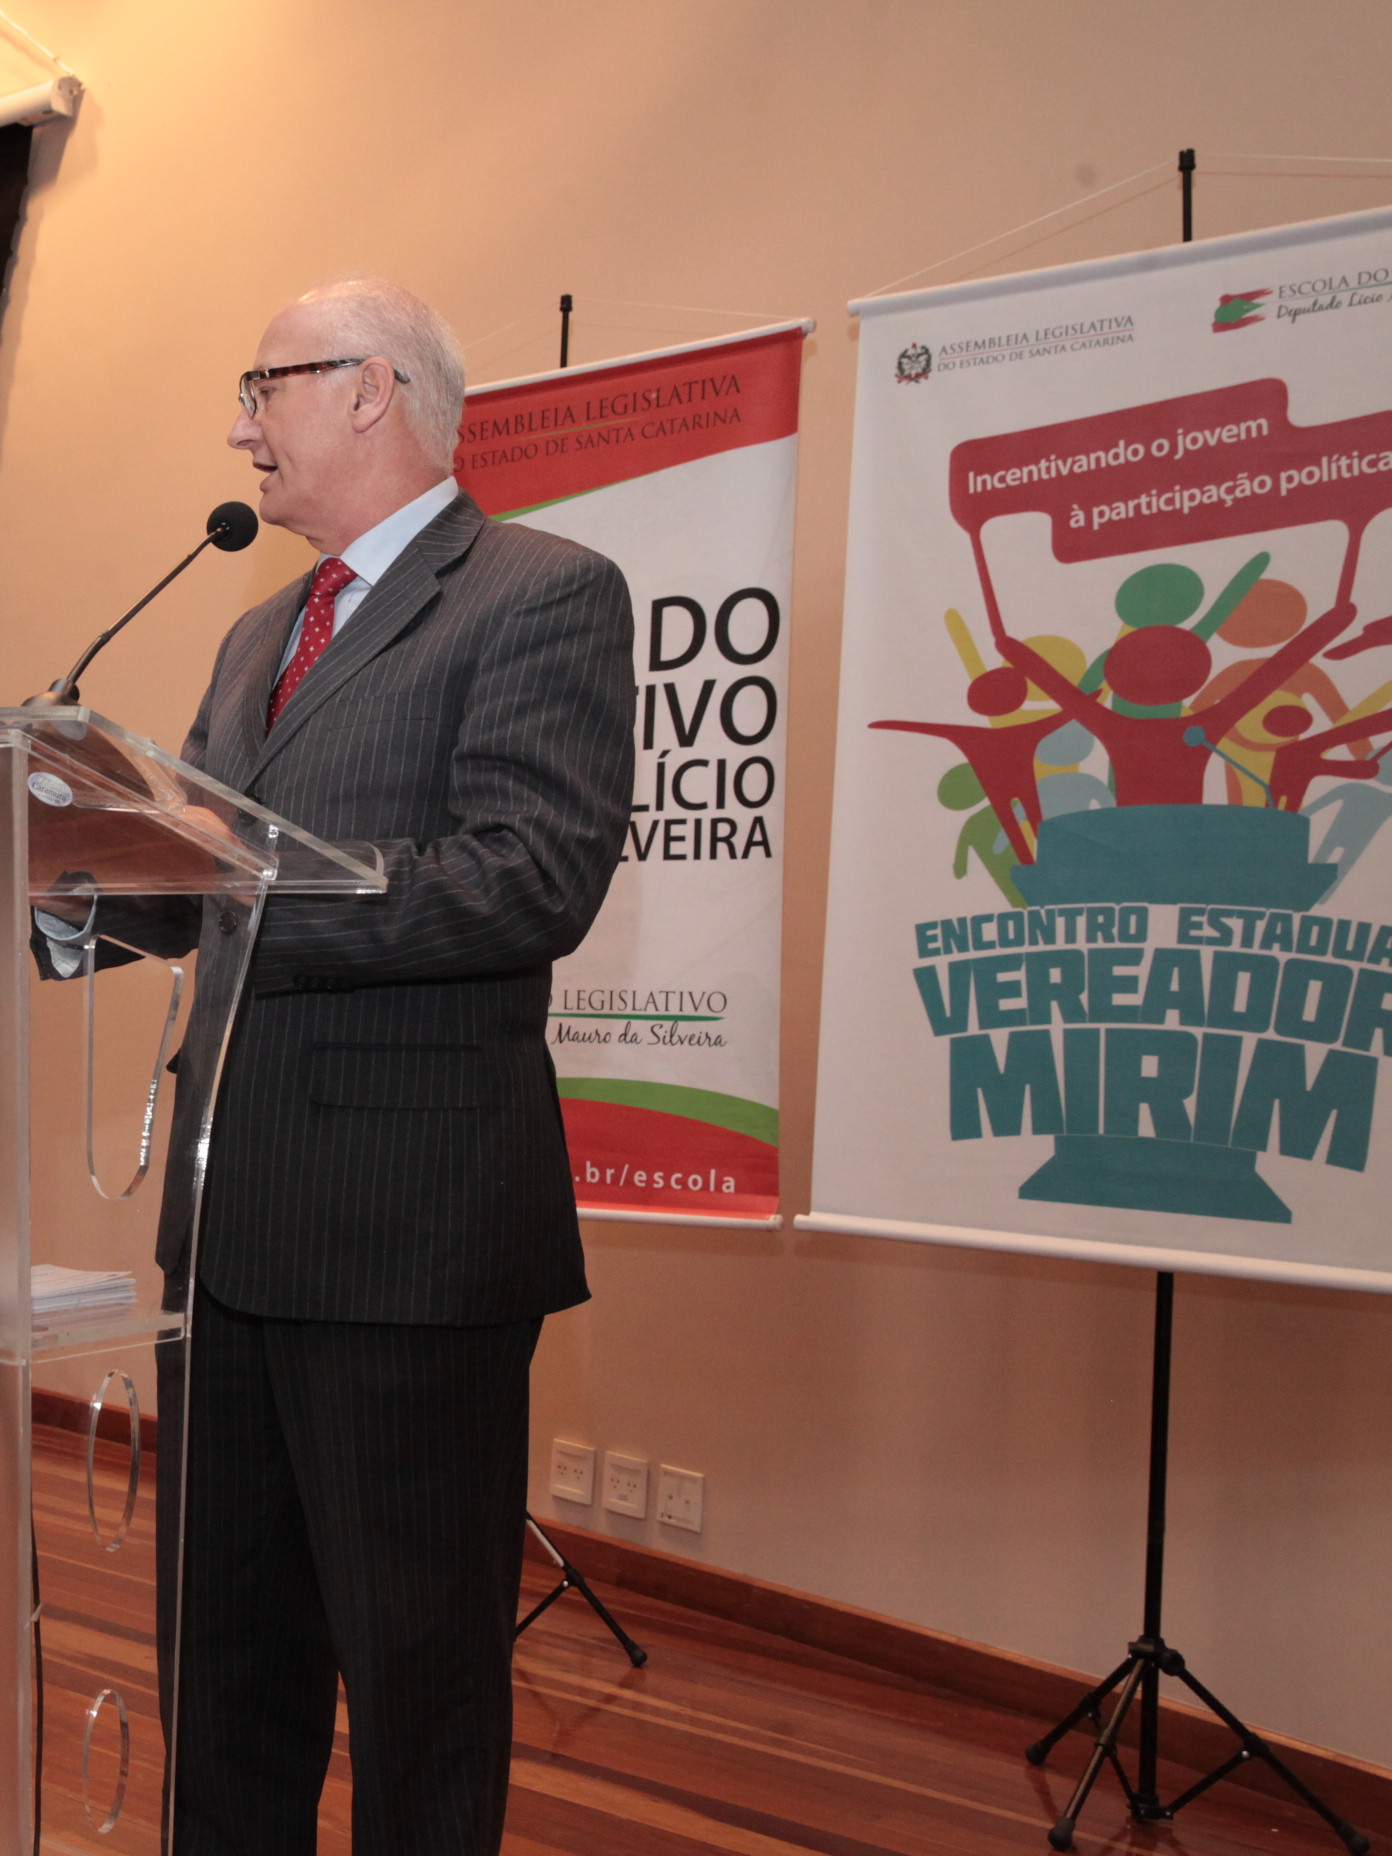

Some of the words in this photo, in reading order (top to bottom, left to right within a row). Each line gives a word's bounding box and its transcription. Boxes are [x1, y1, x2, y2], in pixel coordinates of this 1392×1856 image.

[1276, 295, 1343, 324] Deputado
[1278, 275, 1350, 299] ESCOLA
[1358, 268, 1389, 286] DO
[937, 360, 956, 373] DO
[959, 354, 1005, 370] ESTADO
[1009, 350, 1025, 362] DE
[1028, 343, 1067, 359] SANTA
[1070, 333, 1135, 352] CATARINA
[938, 332, 1030, 357] ASSEMBLEIA
[1035, 315, 1135, 342] LEGISLATIVA
[453, 456, 465, 473] O
[471, 442, 538, 470] ESTADO
[545, 437, 568, 457] DE
[575, 426, 635, 452] SANTA
[641, 407, 742, 439] CATARINA
[457, 405, 577, 446] SSEMBLEIA
[585, 374, 742, 421] LEGISLATIVA
[968, 438, 1145, 494] Incentivando
[1150, 437, 1170, 457] o
[1175, 417, 1269, 460] jovem
[1069, 504, 1086, 528] à
[1092, 472, 1273, 531] participação
[1279, 450, 1392, 496] política
[648, 587, 781, 672] DO
[635, 675, 778, 750] IVO
[619, 815, 773, 863] VEIRA
[915, 906, 1149, 959] ENCONTRO
[1177, 904, 1392, 967] ESTADUA
[563, 989, 728, 1013] LEGISLATIVO
[913, 947, 1392, 1057] VEREADOR
[551, 1022, 612, 1045] Mauro
[617, 1020, 642, 1045] da
[647, 1021, 728, 1048] Silveira
[950, 1027, 1379, 1173] MIRIM
[575, 1160, 736, 1194] .br/escola
